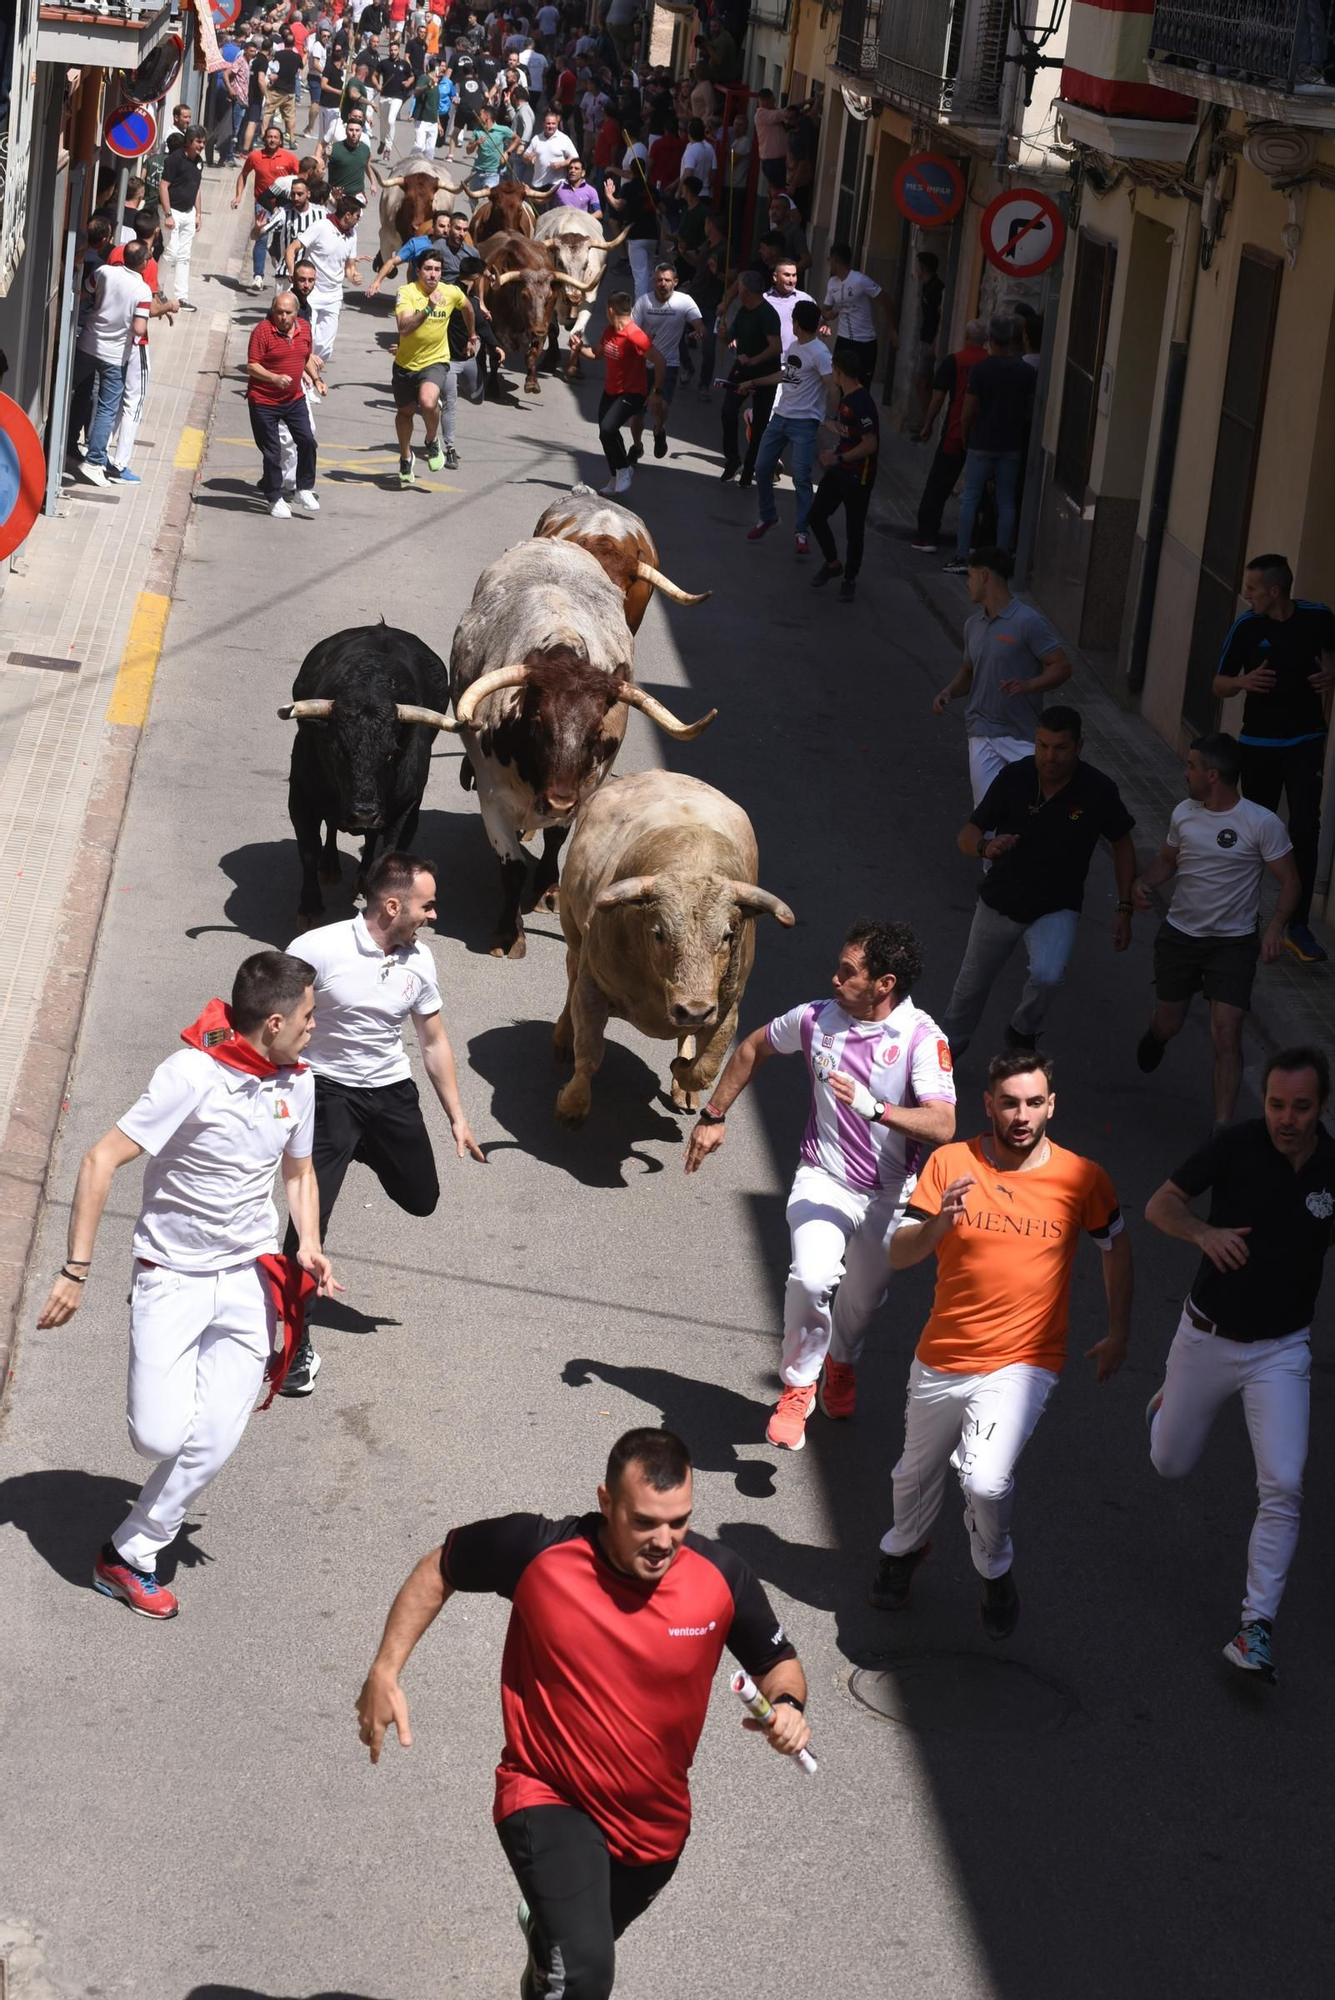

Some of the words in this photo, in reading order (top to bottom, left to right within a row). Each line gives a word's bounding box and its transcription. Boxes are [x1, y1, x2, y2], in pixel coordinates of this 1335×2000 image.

[118, 106, 132, 114] MES
[905, 182, 923, 191] MES
[926, 185, 951, 195] IMPAR
[817, 1056, 830, 1067] 20
[959, 1208, 1063, 1240] MENFIS
[668, 1627, 708, 1637] ventocar
